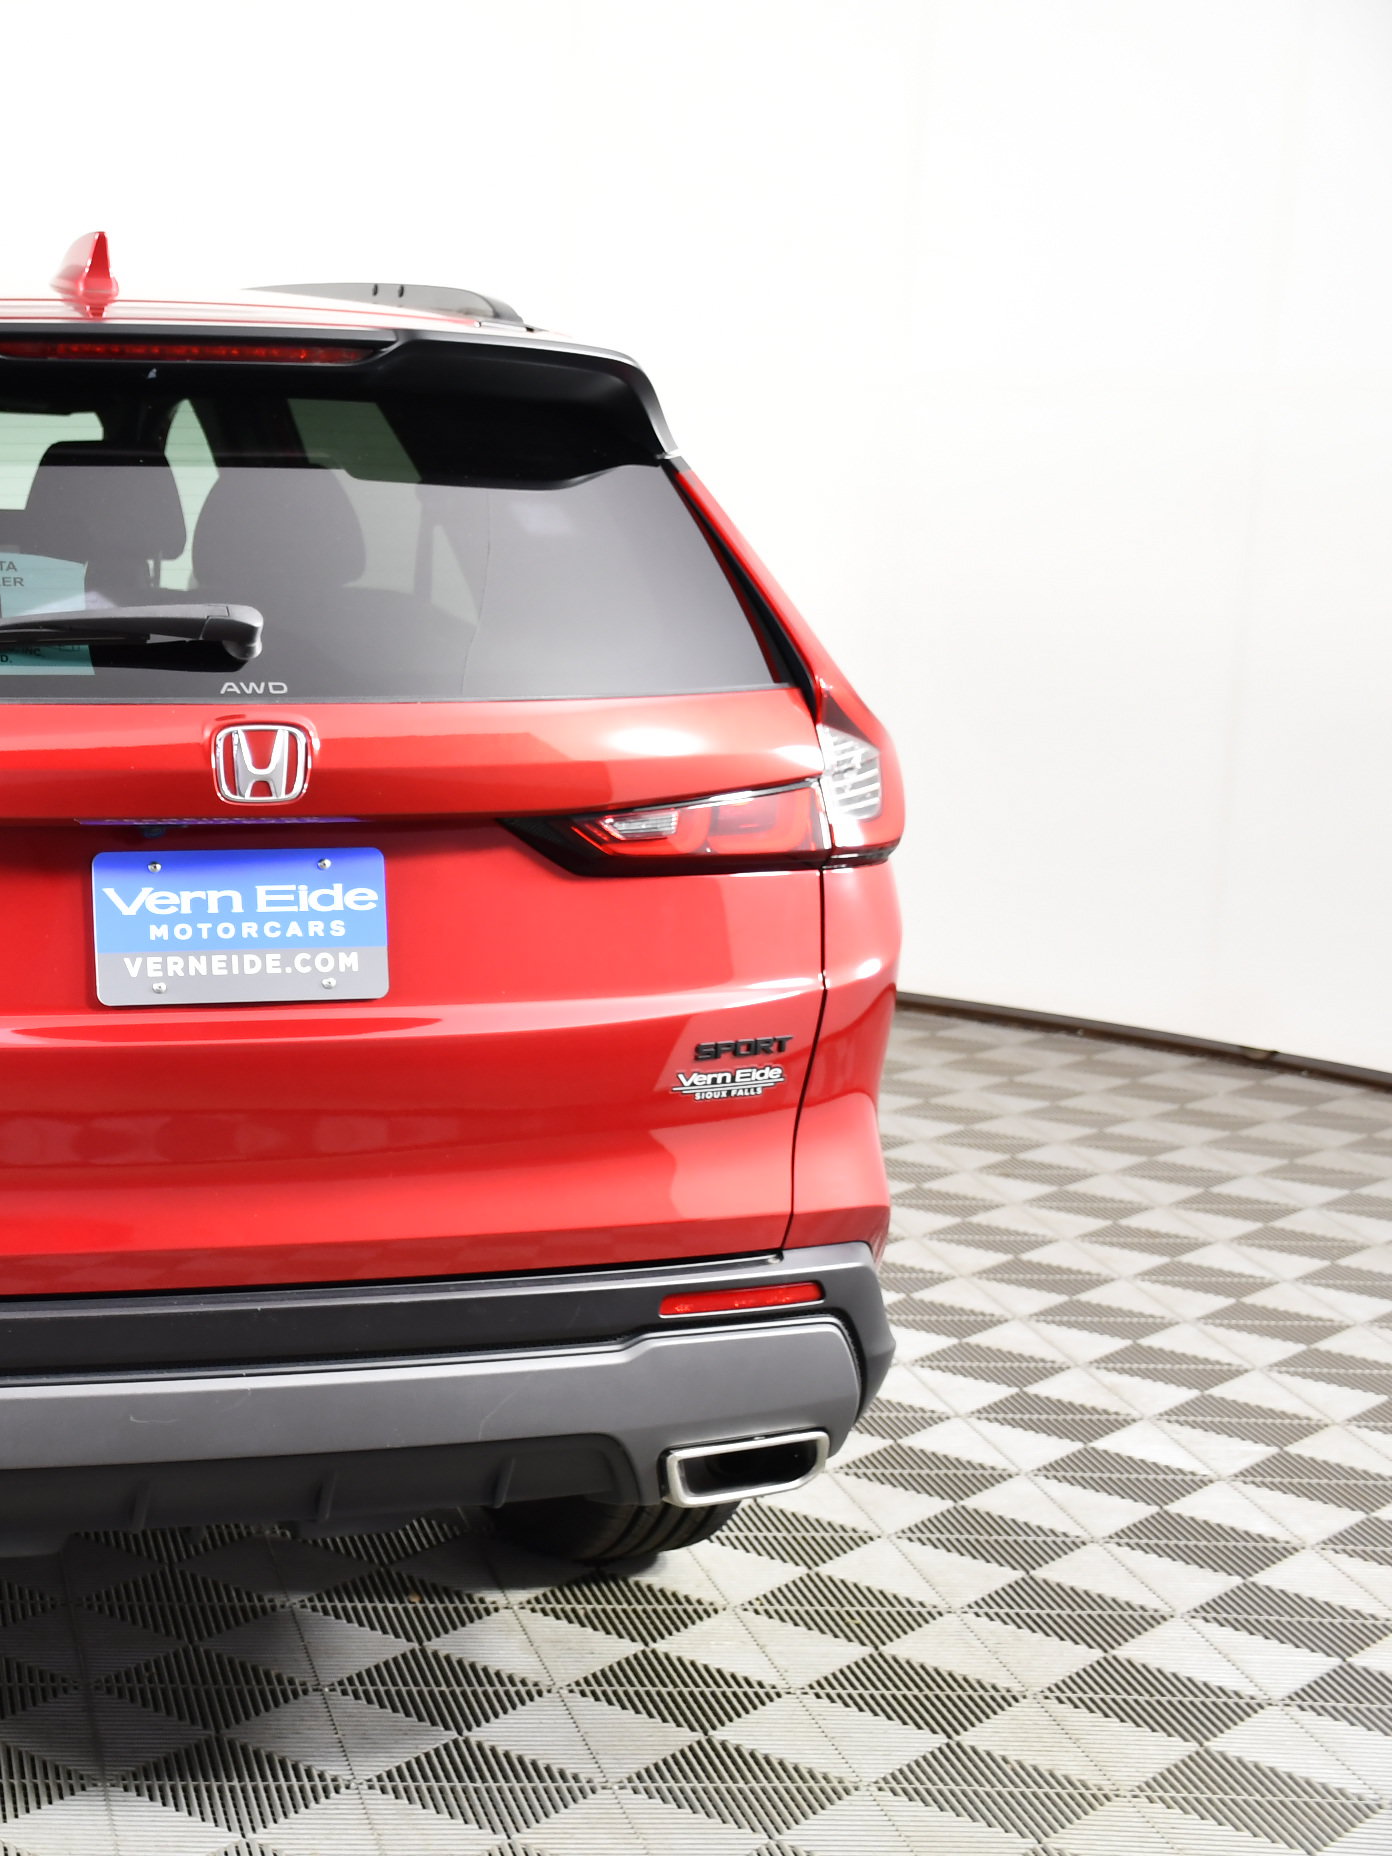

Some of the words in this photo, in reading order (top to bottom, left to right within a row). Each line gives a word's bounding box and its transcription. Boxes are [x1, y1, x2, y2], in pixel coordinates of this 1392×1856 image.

[219, 682, 288, 694] AWD
[102, 886, 244, 916] Vern
[255, 883, 379, 912] Eide
[149, 920, 346, 941] MOTORCARS
[123, 951, 359, 978] VERNEIDE.COM
[693, 1035, 794, 1061] SPORT
[677, 1071, 732, 1087] Vern
[734, 1066, 783, 1083] Eide
[694, 1091, 728, 1100] SIOUX
[730, 1087, 763, 1097] FALLS
